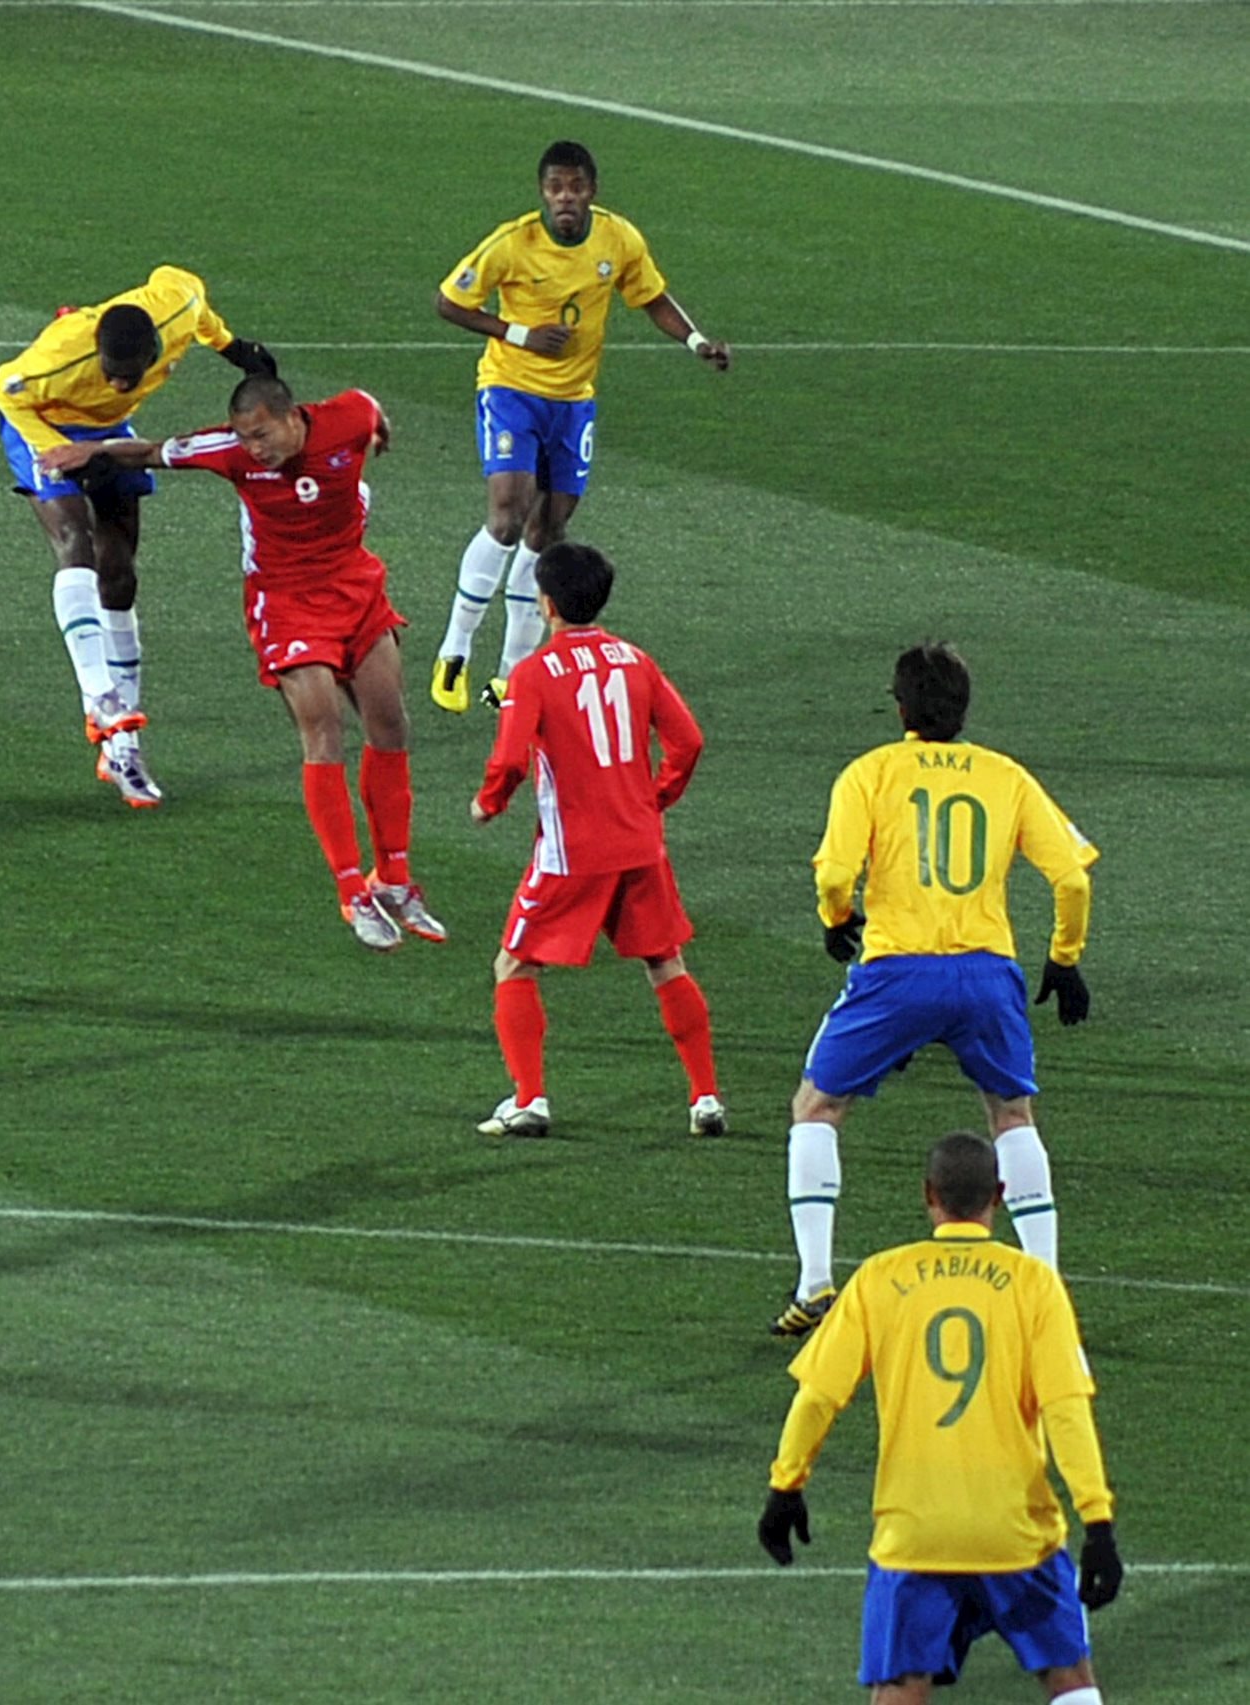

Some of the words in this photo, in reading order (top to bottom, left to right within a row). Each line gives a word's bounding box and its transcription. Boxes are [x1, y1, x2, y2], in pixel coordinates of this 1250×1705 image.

[580, 421, 594, 463] 6
[295, 476, 319, 503] 9
[576, 667, 633, 768] 11
[916, 751, 972, 773] KAKA
[908, 787, 987, 895] 10
[916, 1256, 1012, 1292] FABIANO
[926, 1306, 986, 1428] 9
